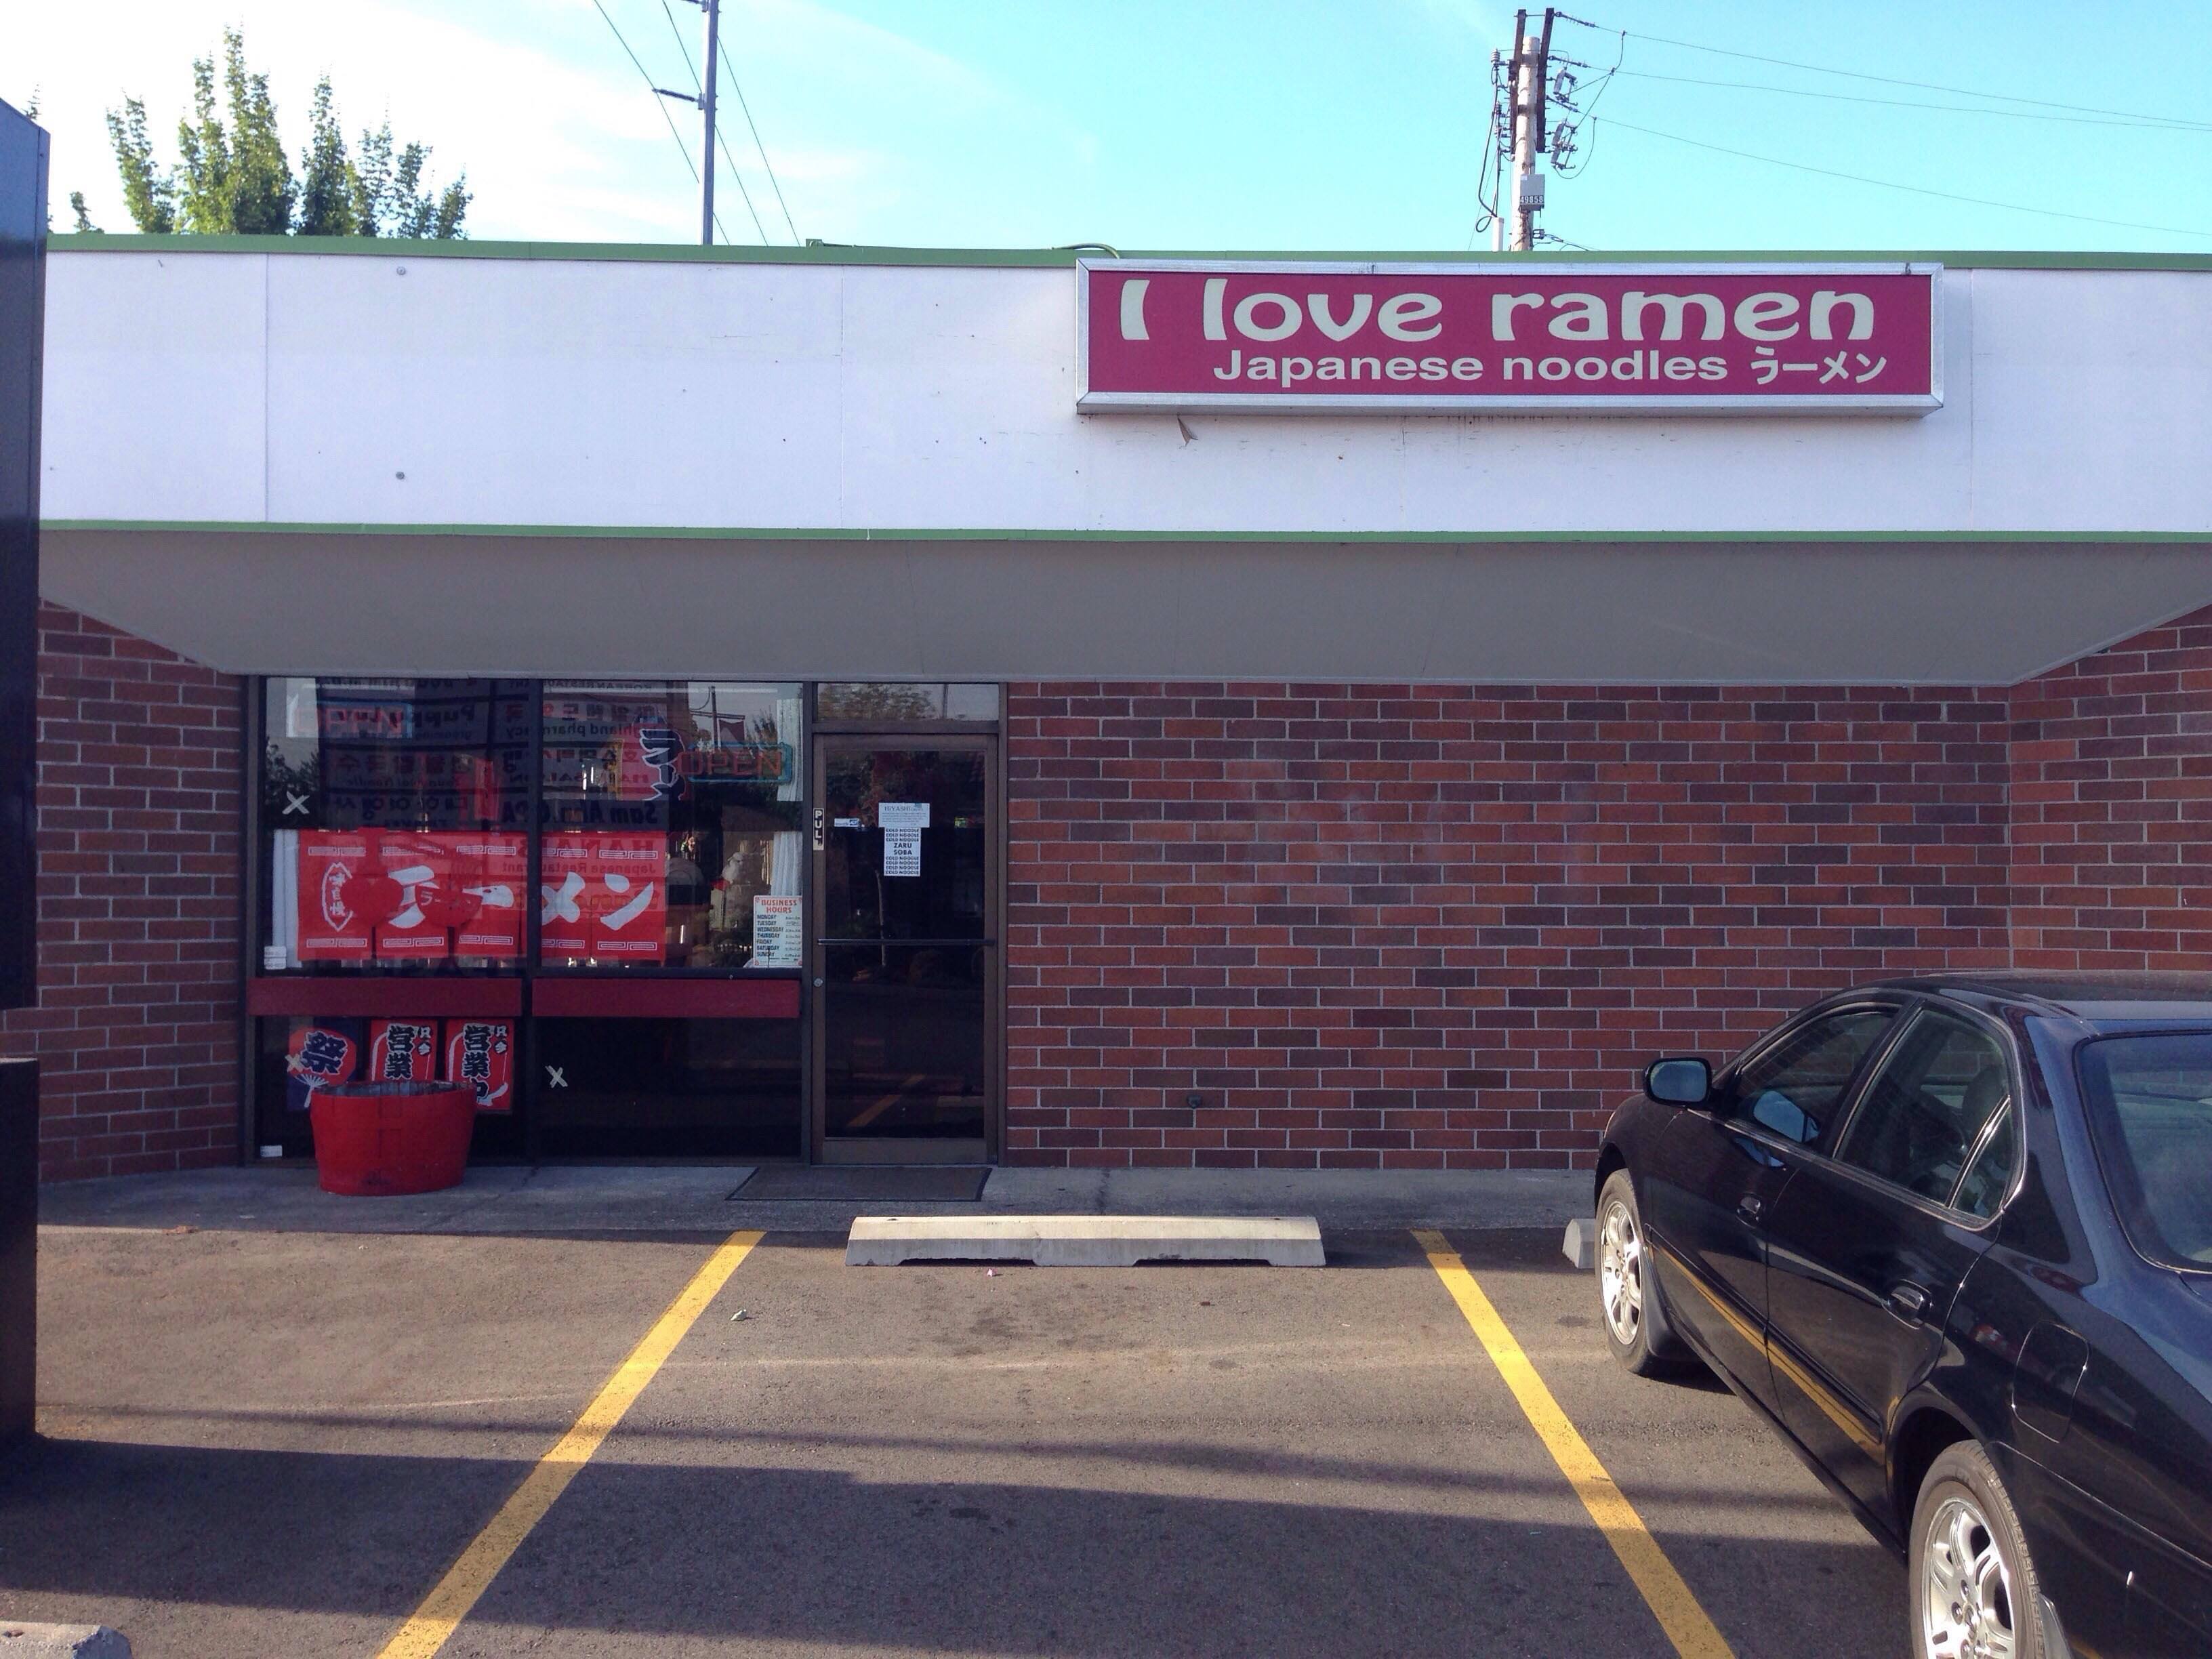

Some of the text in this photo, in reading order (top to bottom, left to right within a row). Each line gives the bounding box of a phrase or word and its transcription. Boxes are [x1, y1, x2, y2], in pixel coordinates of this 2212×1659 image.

[1520, 195, 1544, 203] 49858
[1121, 279, 1875, 342] I love ramen
[1214, 346, 1886, 388] Japanese noodles ラーメン
[677, 748, 782, 776] OPEN
[300, 1031, 348, 1074] 祭
